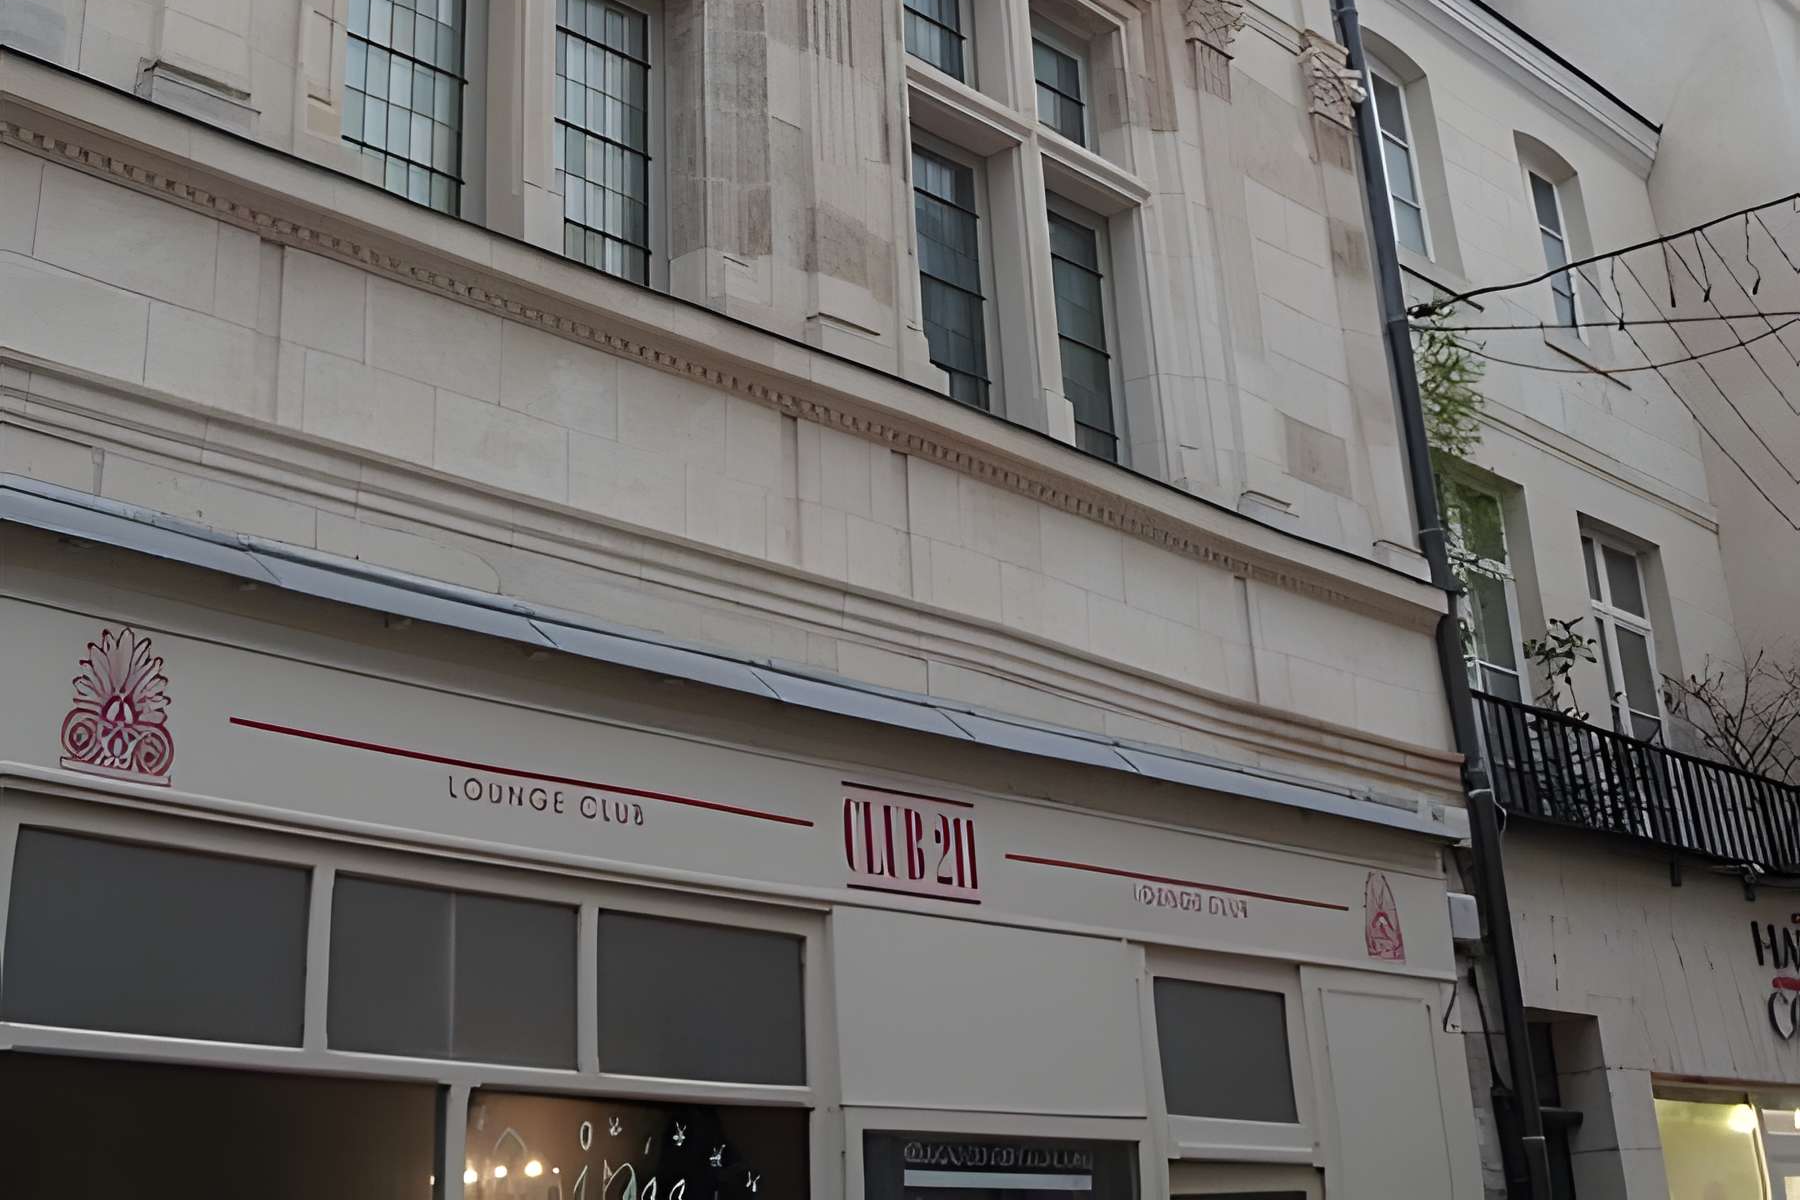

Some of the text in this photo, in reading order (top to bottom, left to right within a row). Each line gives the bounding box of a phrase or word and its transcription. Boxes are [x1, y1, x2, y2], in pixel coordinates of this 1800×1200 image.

[448, 775, 644, 826] LOUNGE CLUB
[843, 798, 925, 881] CLUB
